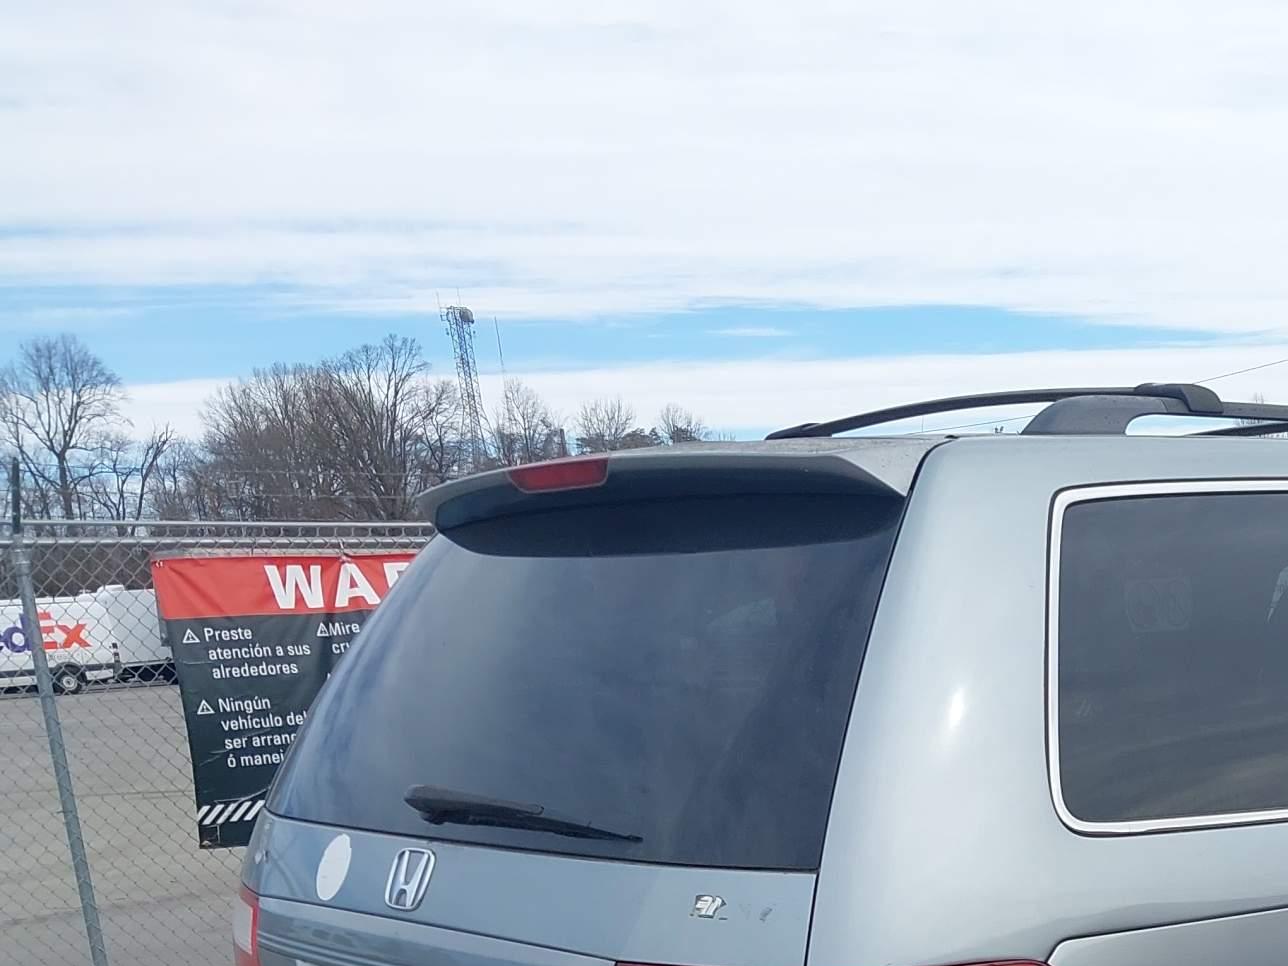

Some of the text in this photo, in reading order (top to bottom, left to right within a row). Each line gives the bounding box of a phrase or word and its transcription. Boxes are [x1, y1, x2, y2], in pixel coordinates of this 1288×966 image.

[203, 627, 253, 643] Preste
[328, 621, 361, 637] Mire
[208, 643, 312, 661] atención a sus
[211, 661, 299, 680] alrededores
[217, 696, 272, 715] Ningún
[220, 712, 283, 732] vehículo
[224, 736, 252, 750] ser
